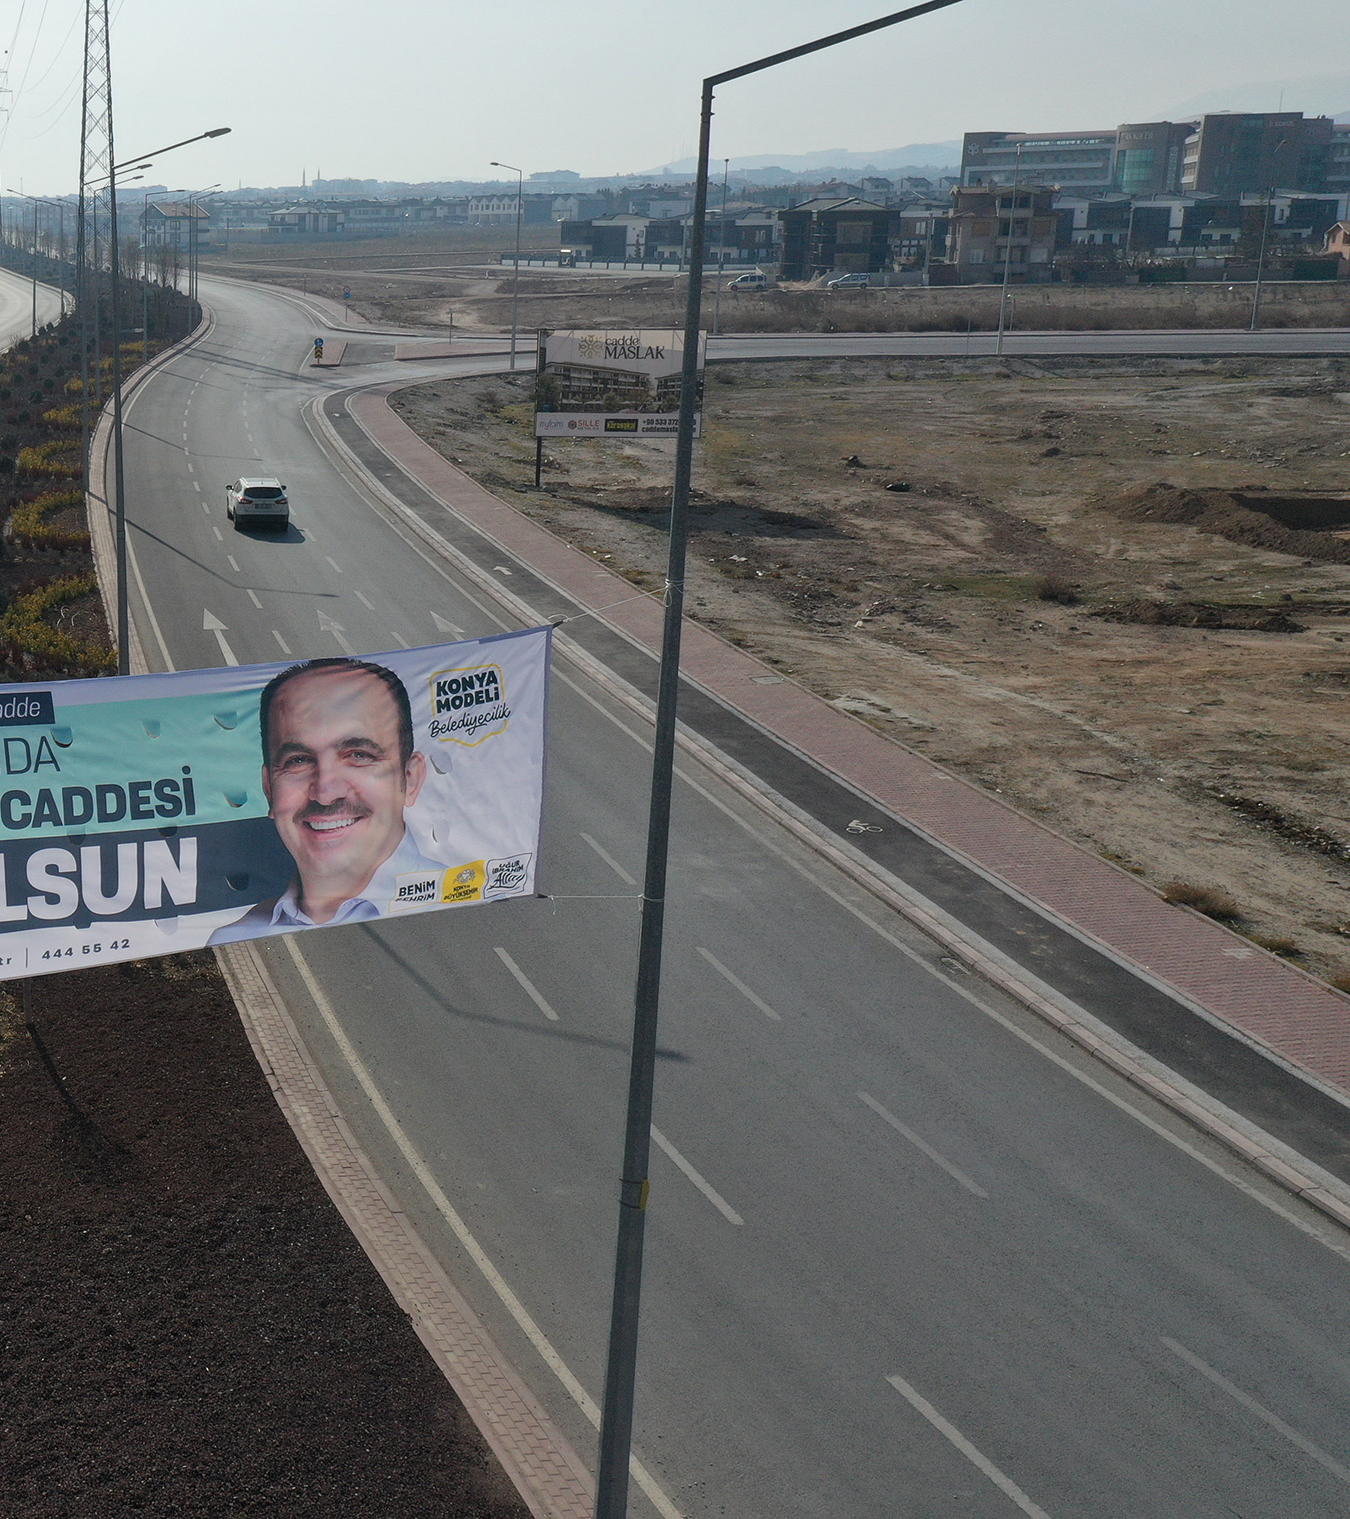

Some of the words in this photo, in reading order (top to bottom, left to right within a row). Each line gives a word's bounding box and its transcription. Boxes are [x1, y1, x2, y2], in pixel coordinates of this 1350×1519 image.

[603, 345, 665, 360] MASLAK
[605, 335, 639, 346] cadde
[436, 670, 498, 697] KONYA
[435, 687, 500, 714] MODELİ
[428, 702, 511, 738] Belediyecilik
[0, 765, 197, 829] CADDESİ
[398, 879, 436, 897] BENİM
[41, 946, 74, 960] 444
[81, 942, 103, 956] 55
[110, 938, 131, 951] 42
